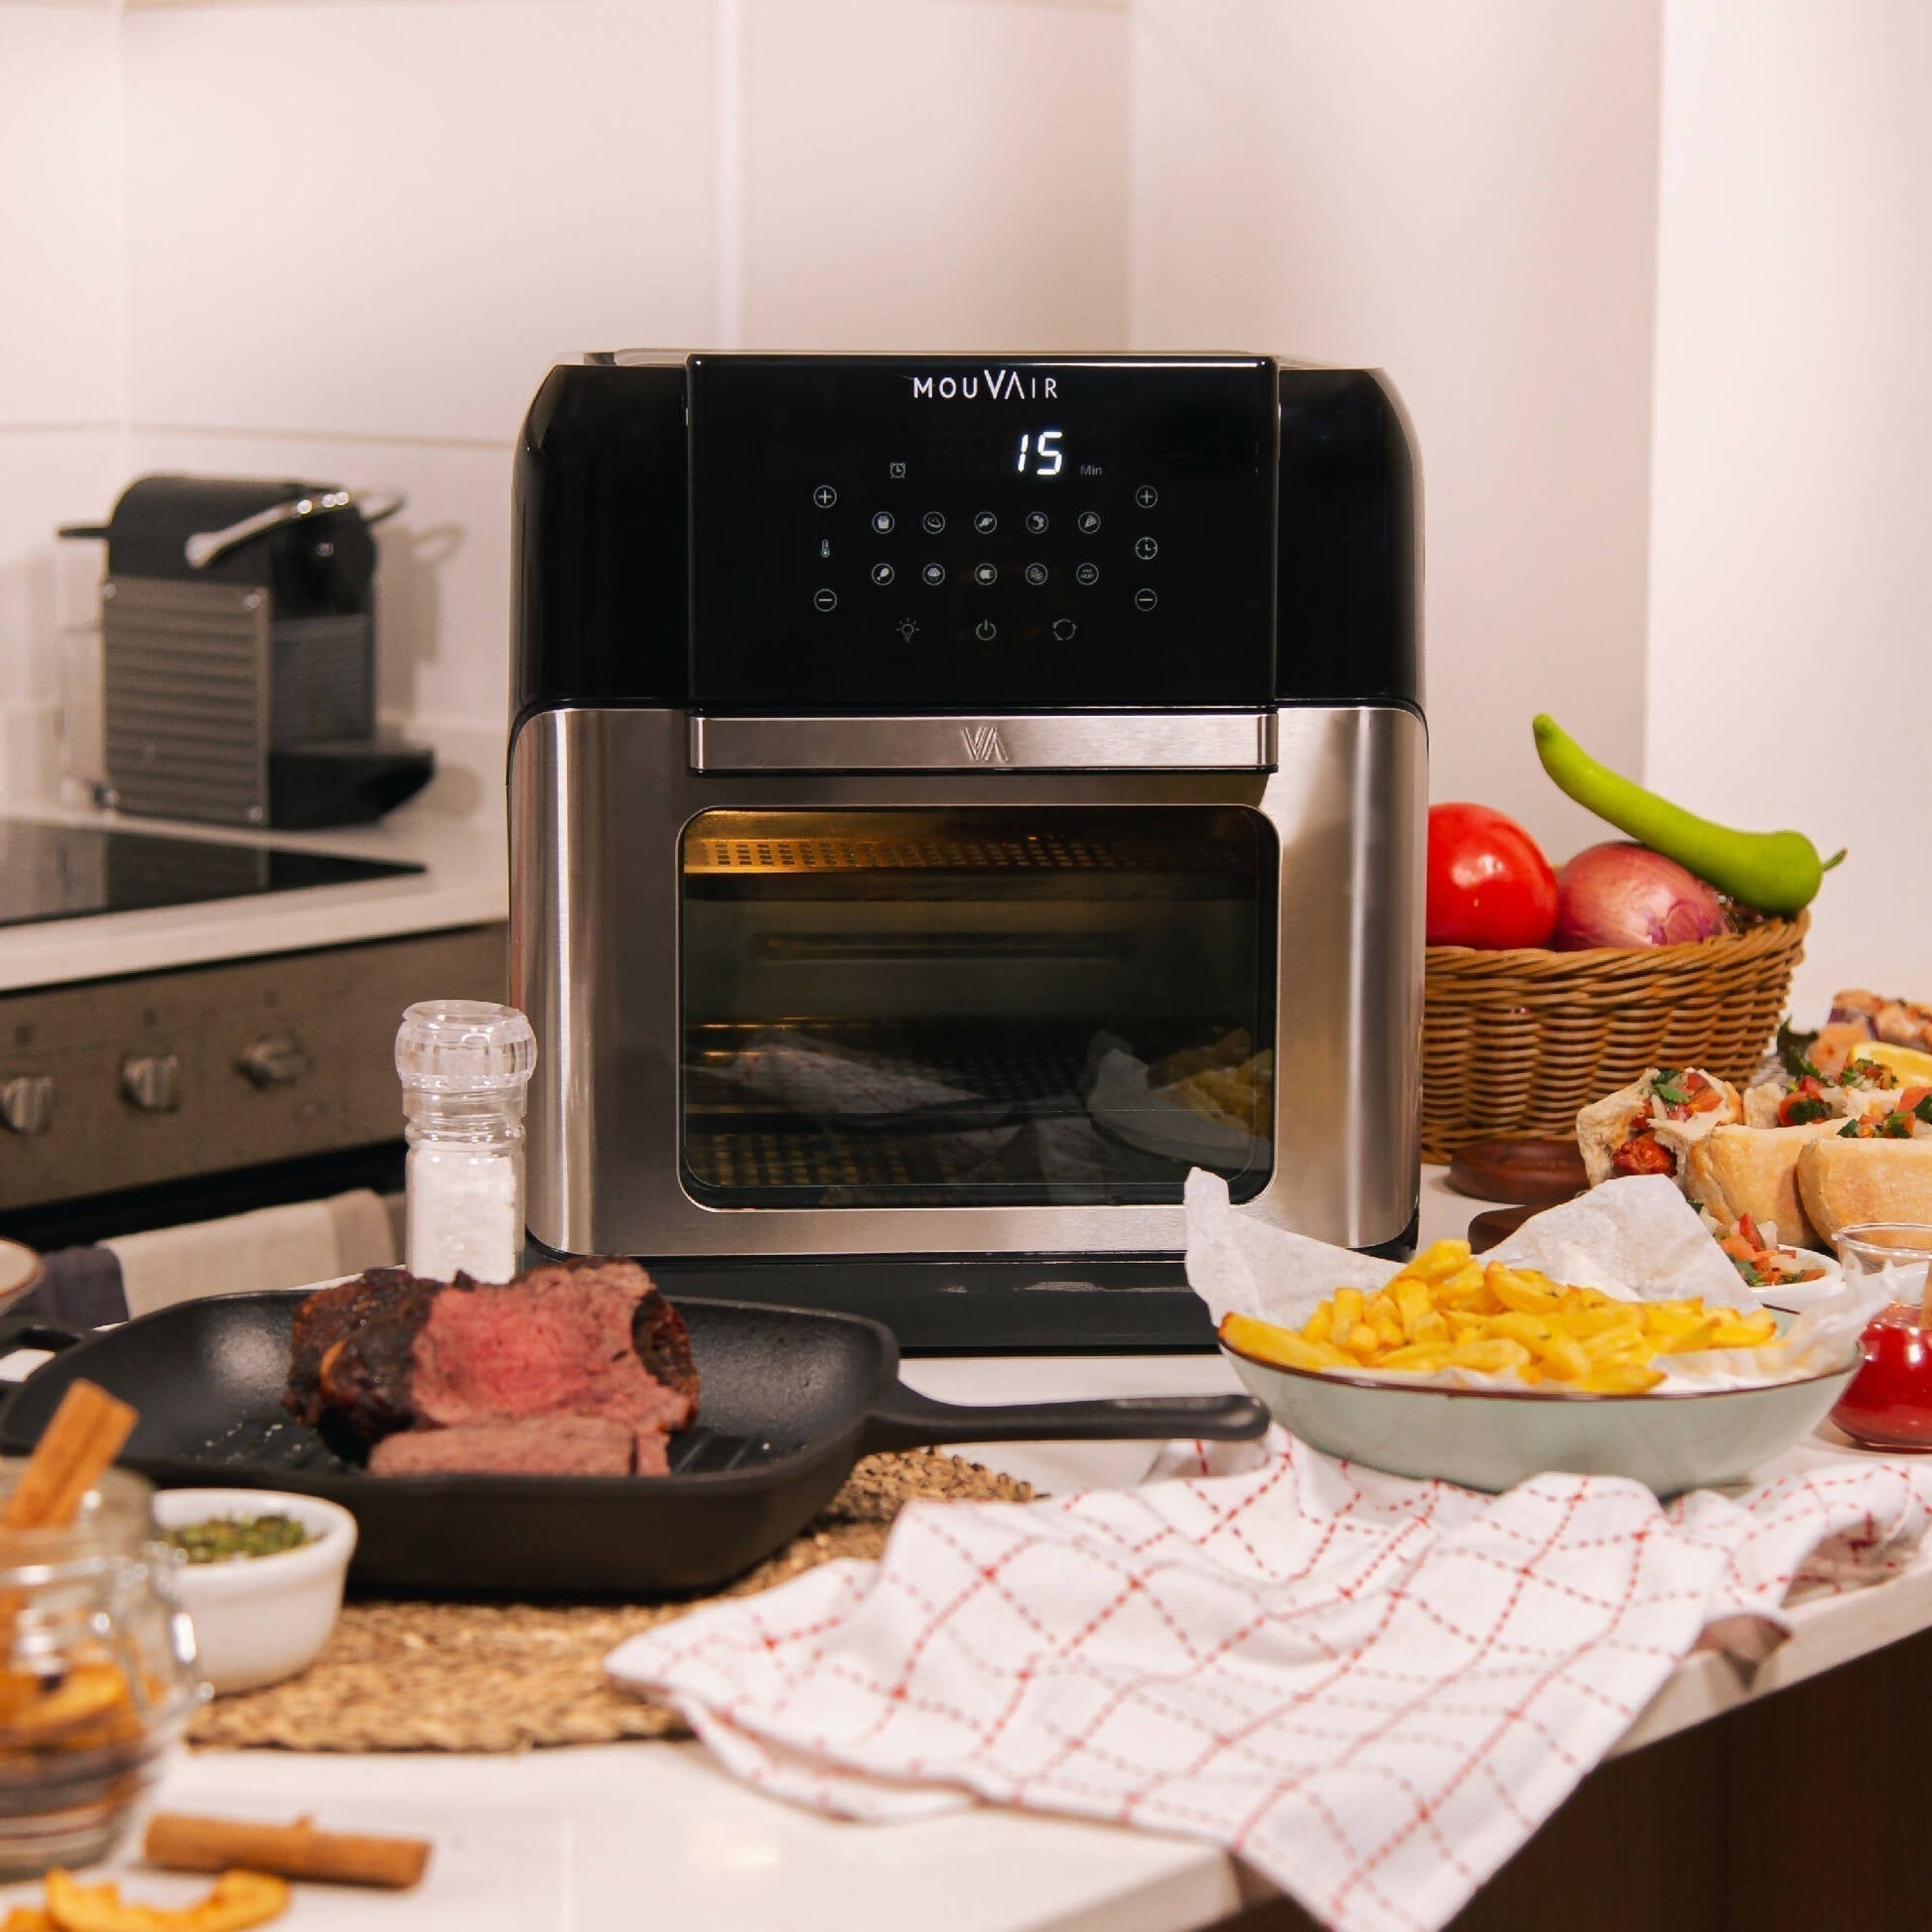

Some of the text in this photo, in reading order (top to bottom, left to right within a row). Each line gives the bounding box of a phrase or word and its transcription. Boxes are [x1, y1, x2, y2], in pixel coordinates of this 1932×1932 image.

[912, 368, 1058, 400] MOUVAIR
[1017, 431, 1063, 476] 15
[1080, 465, 1103, 476] Min
